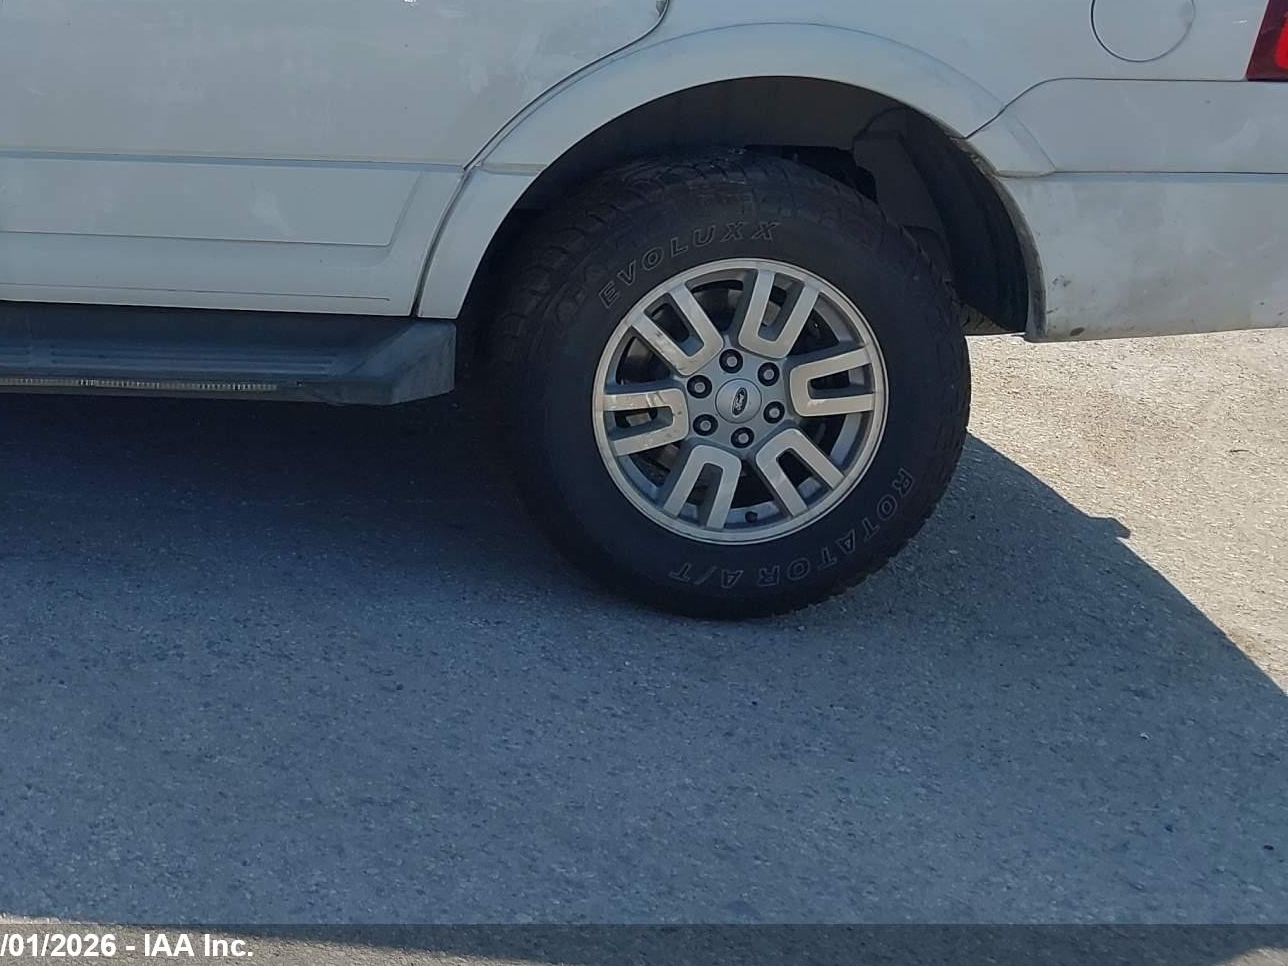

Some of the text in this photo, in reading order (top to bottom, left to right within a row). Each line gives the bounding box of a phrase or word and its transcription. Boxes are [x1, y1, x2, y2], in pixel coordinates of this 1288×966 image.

[598, 219, 783, 310] EVOLUXX
[668, 467, 916, 589] ROTATOR A/T
